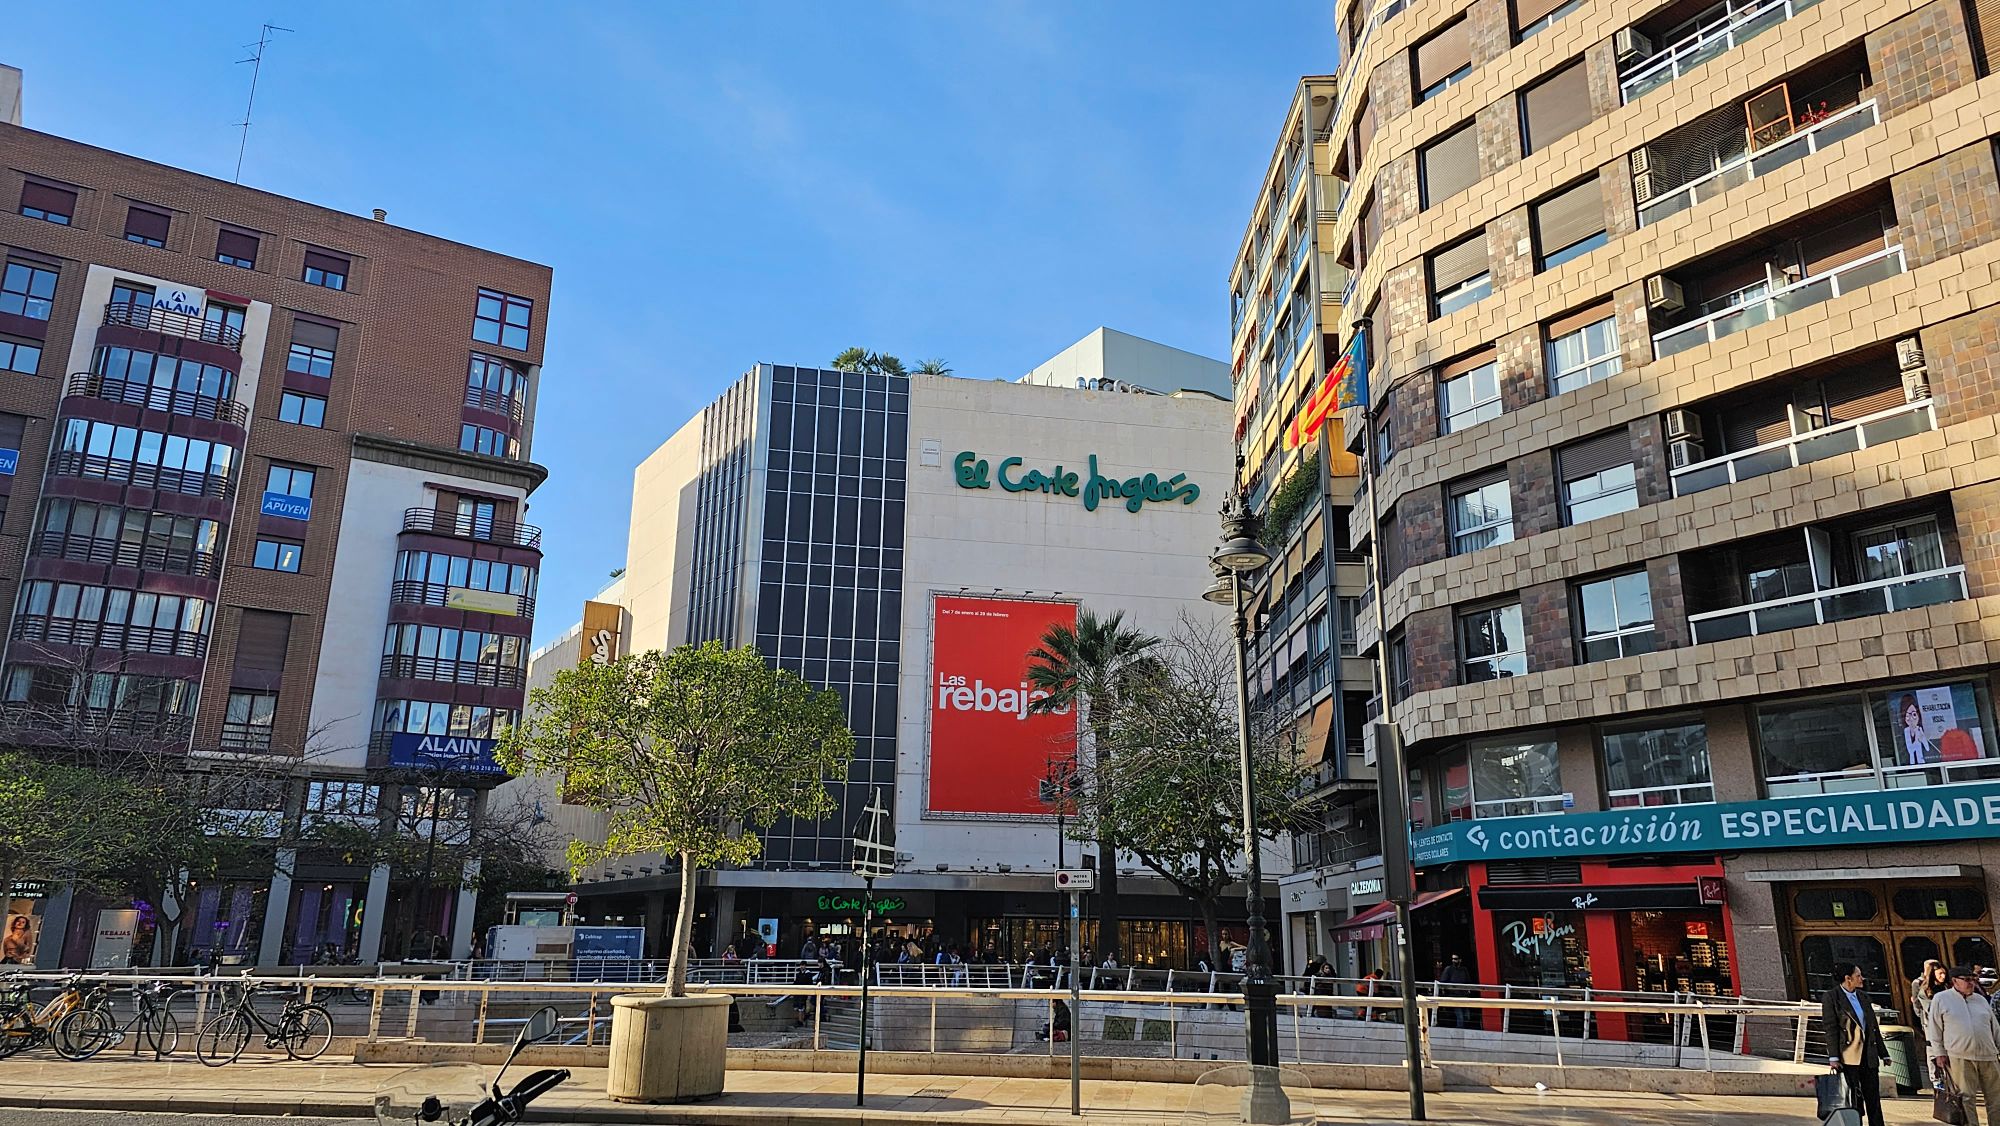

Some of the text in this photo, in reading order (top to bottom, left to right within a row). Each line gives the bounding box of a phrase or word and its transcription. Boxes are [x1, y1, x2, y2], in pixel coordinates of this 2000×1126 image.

[155, 299, 200, 316] ALAIN
[955, 451, 1200, 514] El Corte Inglés
[264, 501, 309, 516] APUYEN
[939, 671, 967, 686] Las
[418, 736, 481, 754] ALAIN
[1499, 811, 1702, 850] contacvisión
[818, 896, 830, 910] El
[832, 895, 861, 911] Corte
